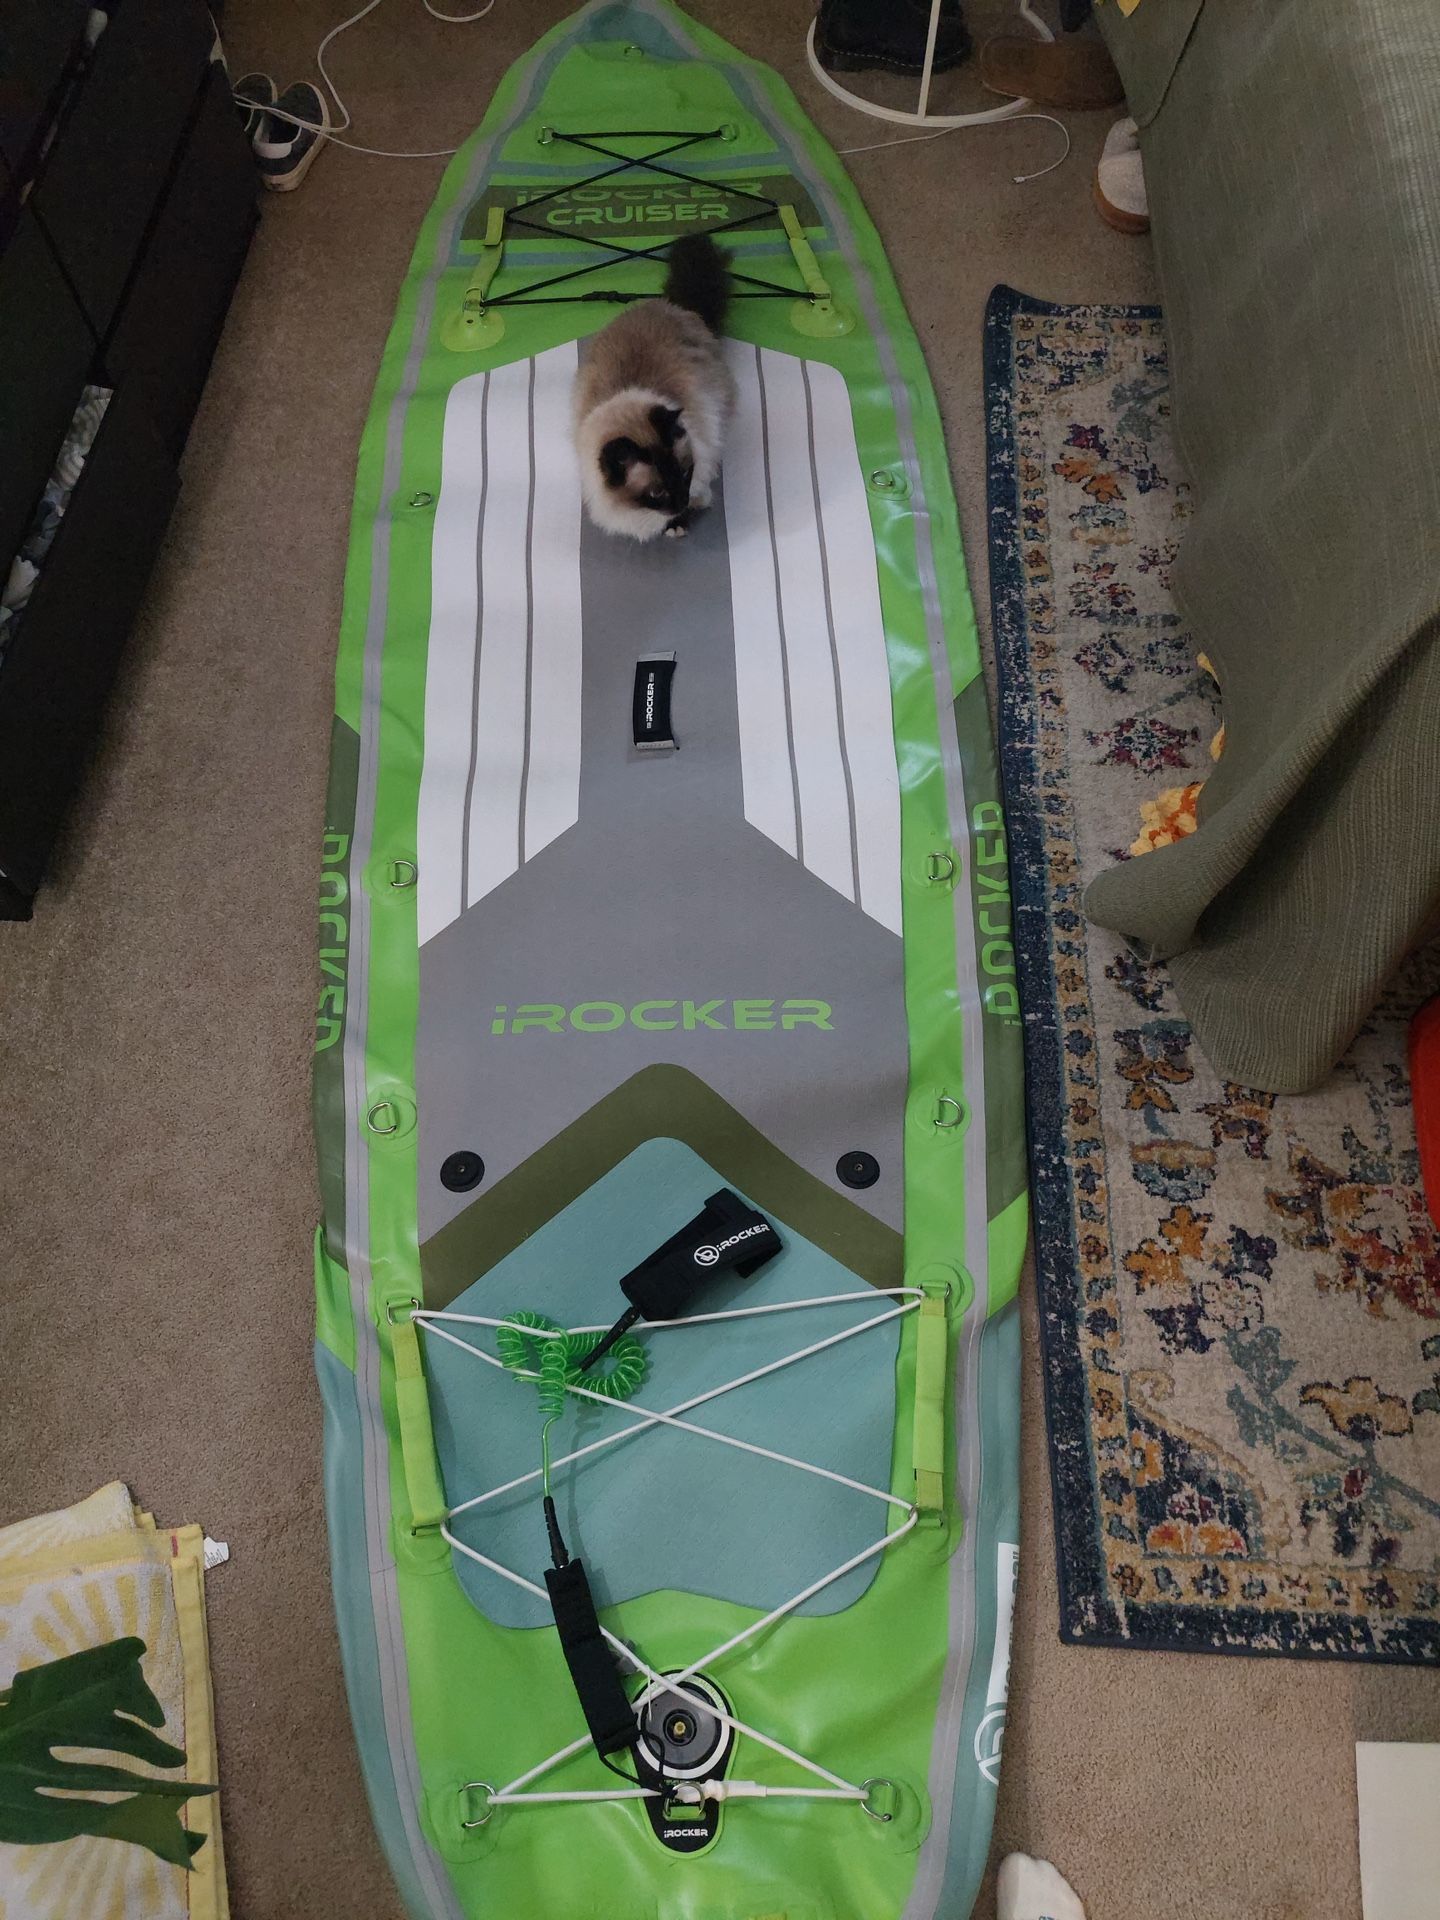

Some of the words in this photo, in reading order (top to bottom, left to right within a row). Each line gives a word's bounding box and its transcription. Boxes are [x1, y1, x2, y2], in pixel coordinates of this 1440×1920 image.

[545, 202, 731, 226] CRUISER
[645, 682, 655, 722] iROCKER
[490, 998, 836, 1036] iROCKER
[716, 1223, 771, 1252] iROCKER
[663, 1828, 709, 1839] iROCKER
